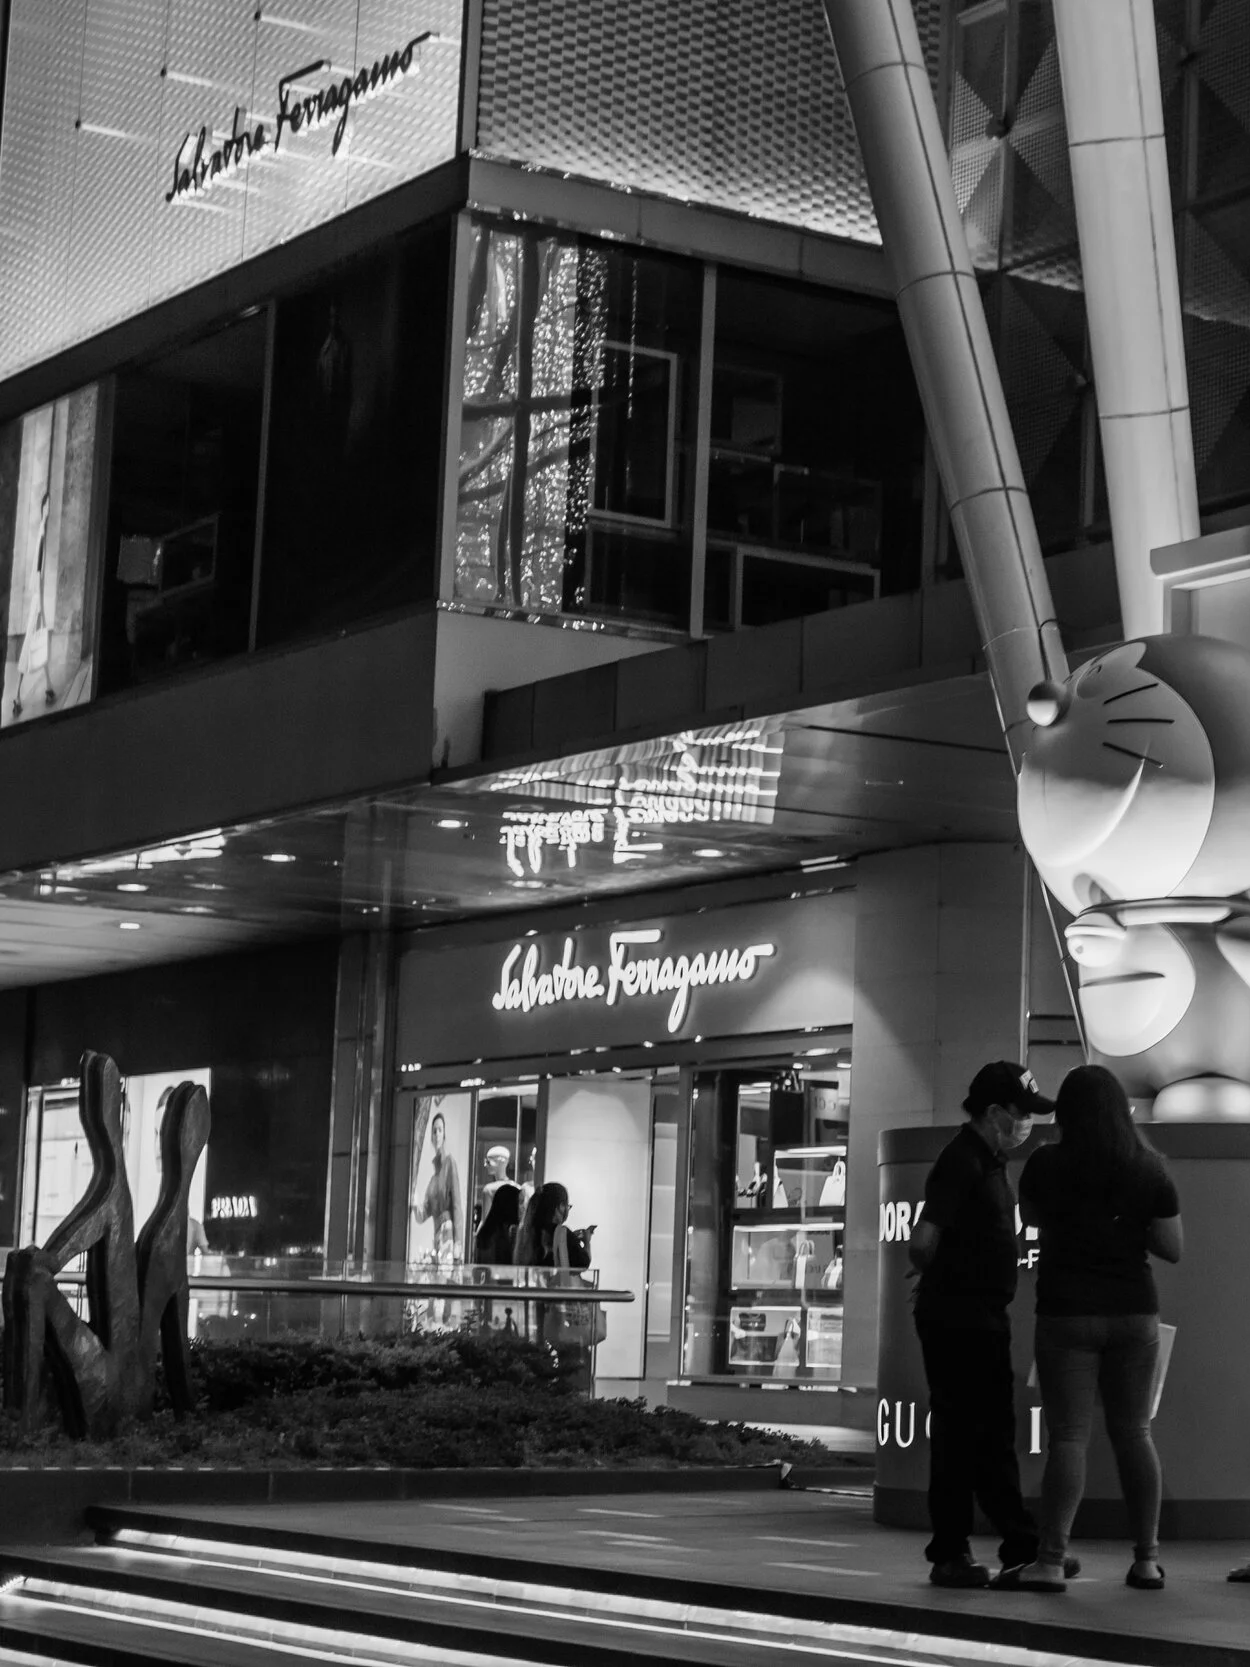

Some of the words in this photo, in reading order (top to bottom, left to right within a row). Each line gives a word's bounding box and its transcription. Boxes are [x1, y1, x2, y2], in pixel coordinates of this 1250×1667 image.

[165, 106, 274, 202] Salvatore
[275, 31, 433, 157] Ferragamo
[492, 936, 605, 1013] Salvatore
[605, 928, 775, 1034] Ferragamo
